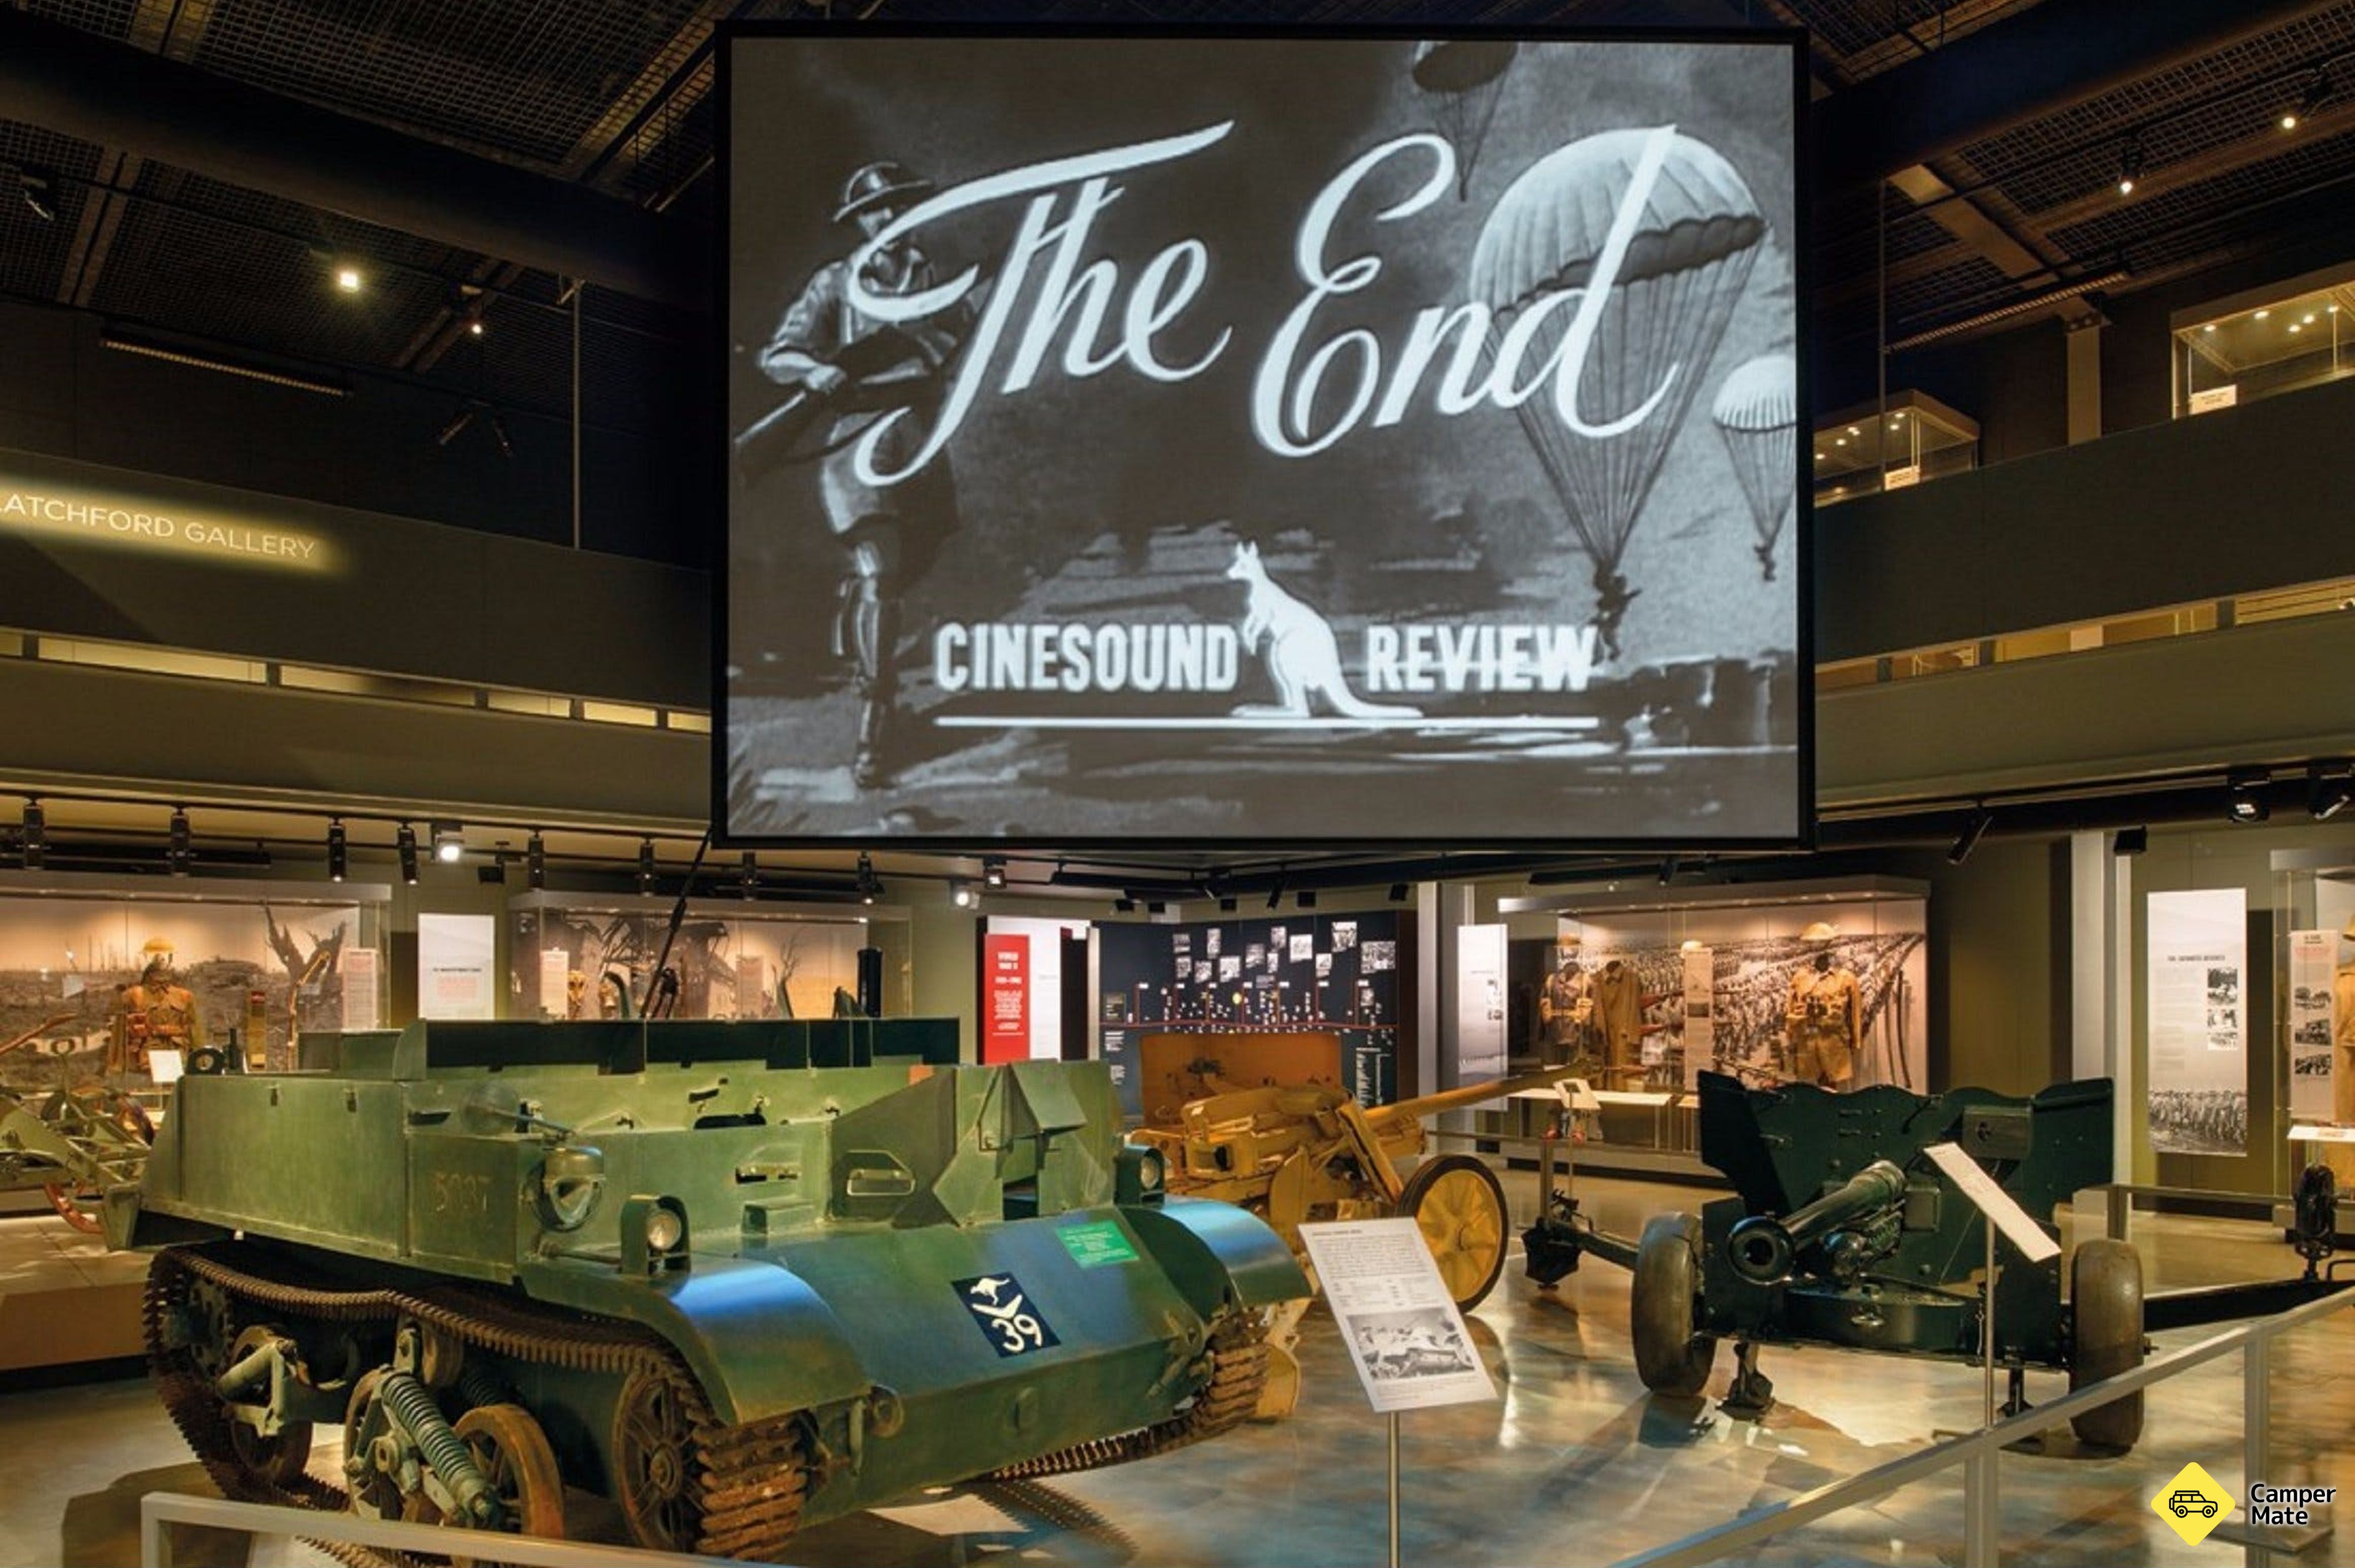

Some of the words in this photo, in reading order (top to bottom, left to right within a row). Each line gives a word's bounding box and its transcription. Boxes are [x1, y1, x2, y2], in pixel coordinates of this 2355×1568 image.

[848, 120, 1235, 485] The
[1251, 124, 1677, 457] End
[0, 493, 174, 538] ATCHFORD
[185, 521, 314, 558] GALLERY
[935, 623, 1238, 693] CINESOUND
[1366, 624, 1598, 693] REVIEW
[991, 1313, 1043, 1353] 39
